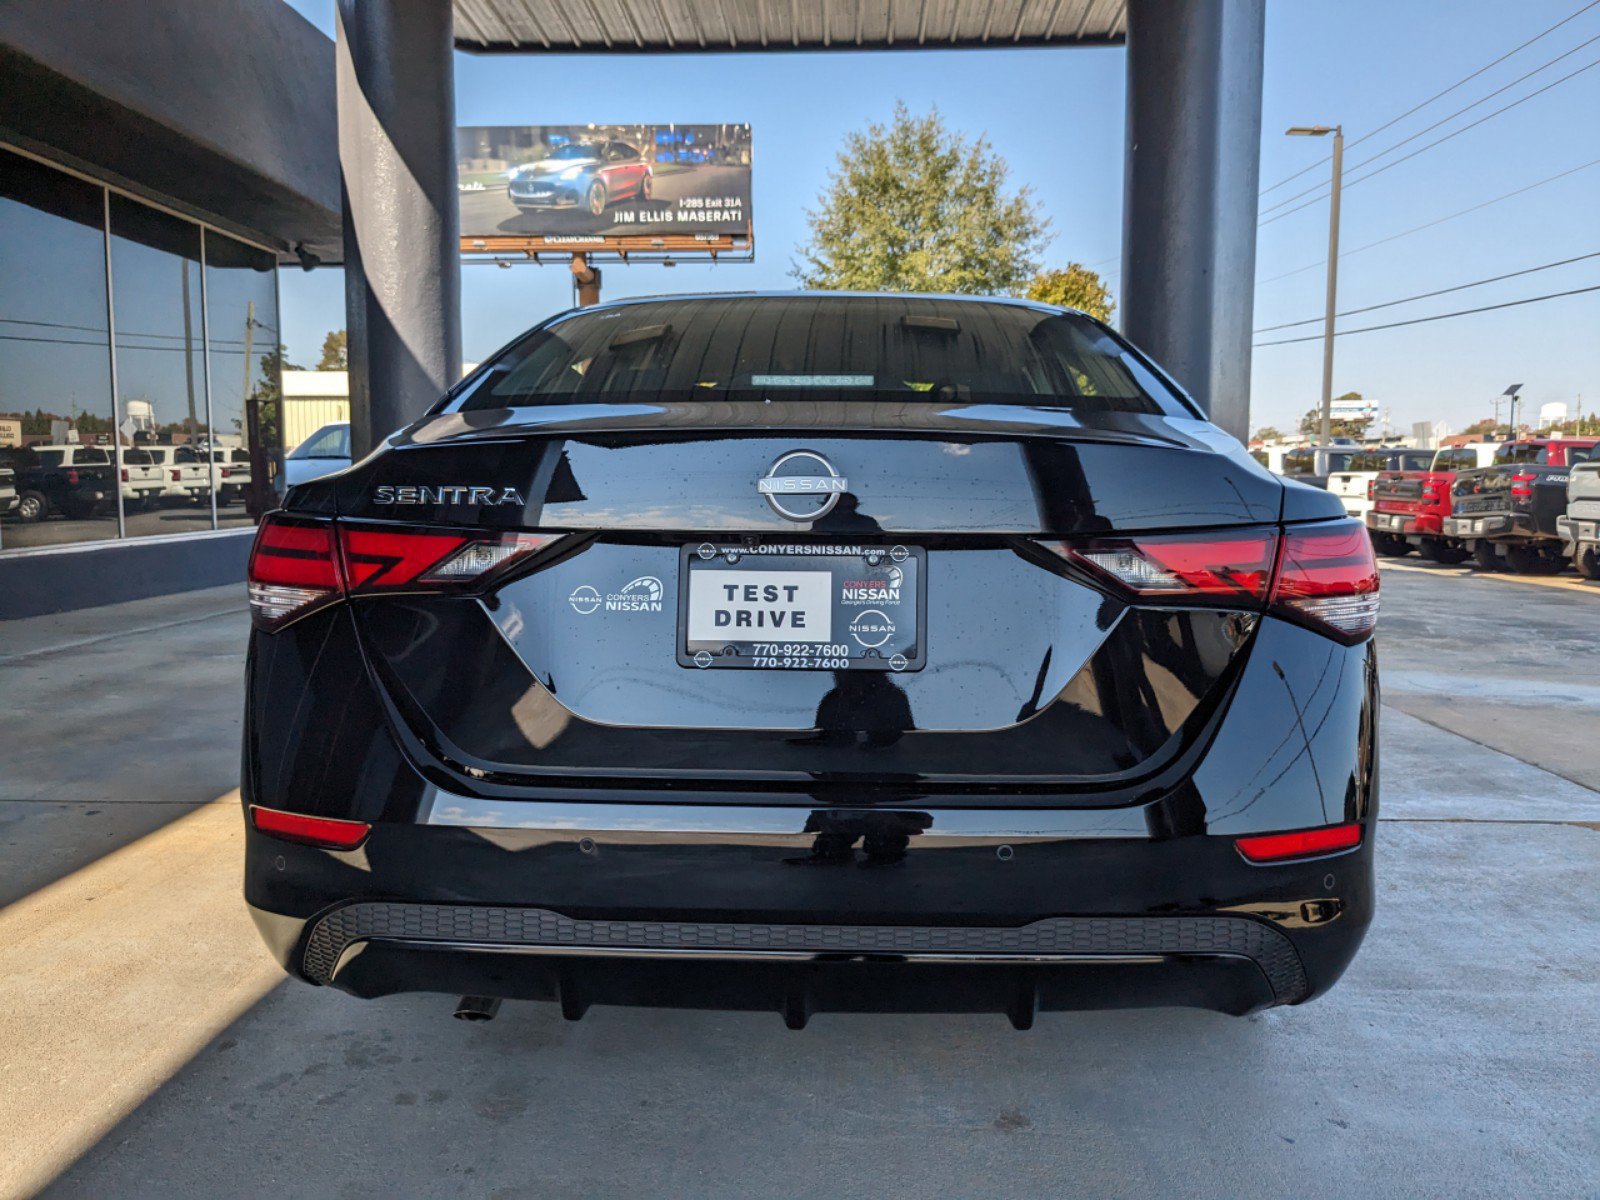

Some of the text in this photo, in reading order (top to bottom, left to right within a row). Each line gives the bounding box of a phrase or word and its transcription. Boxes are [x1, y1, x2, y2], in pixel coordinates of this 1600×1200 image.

[613, 210, 743, 223] JIM ELLIS MASERATI
[758, 478, 846, 491] NISSAN
[373, 485, 525, 506] SENTRA
[720, 544, 886, 556] www.CONYERSNISSAN.com
[843, 580, 887, 588] CONYERS
[606, 593, 650, 601] CONYERS
[723, 584, 799, 602] TEST
[842, 588, 900, 600] NISSAN
[605, 601, 662, 612] NISSAN
[714, 609, 806, 628] DRIVE
[752, 643, 849, 658] 770-922-7600
[752, 657, 850, 669] 770-922-7600
